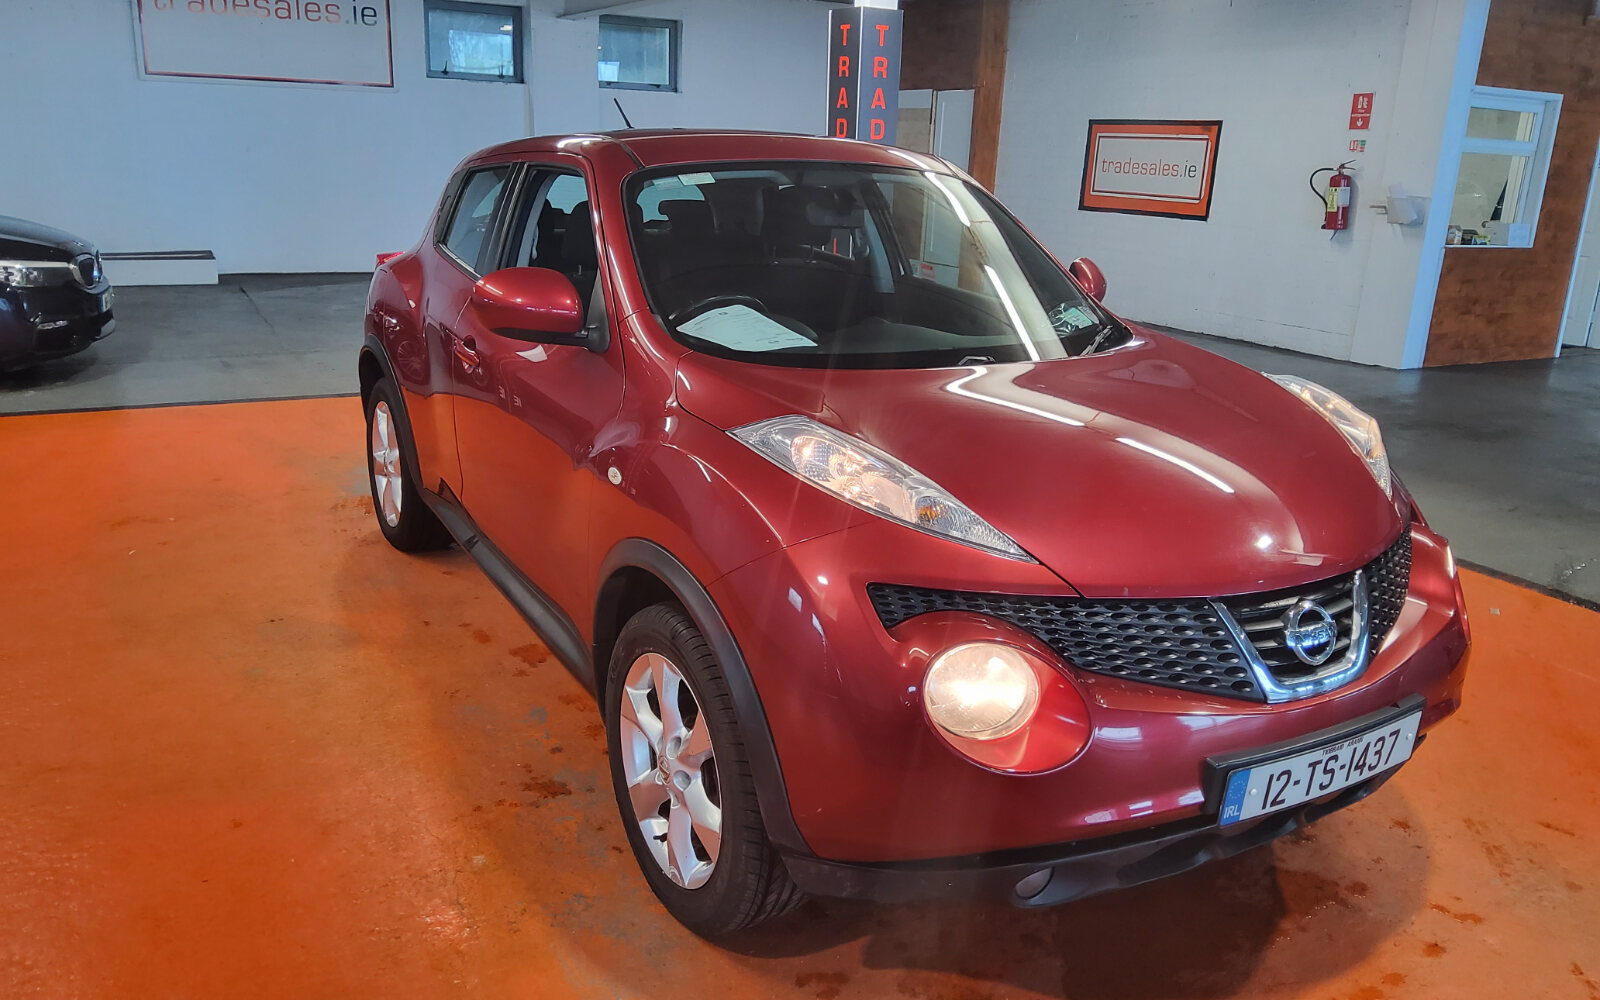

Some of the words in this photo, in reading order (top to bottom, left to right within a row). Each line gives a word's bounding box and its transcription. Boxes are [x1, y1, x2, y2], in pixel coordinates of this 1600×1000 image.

[836, 24, 851, 138] TRAD
[870, 24, 889, 140] TRAD
[1101, 157, 1197, 178] tradesales.ie
[1261, 728, 1402, 810] 12-TS-1437
[1223, 804, 1240, 819] IRL
